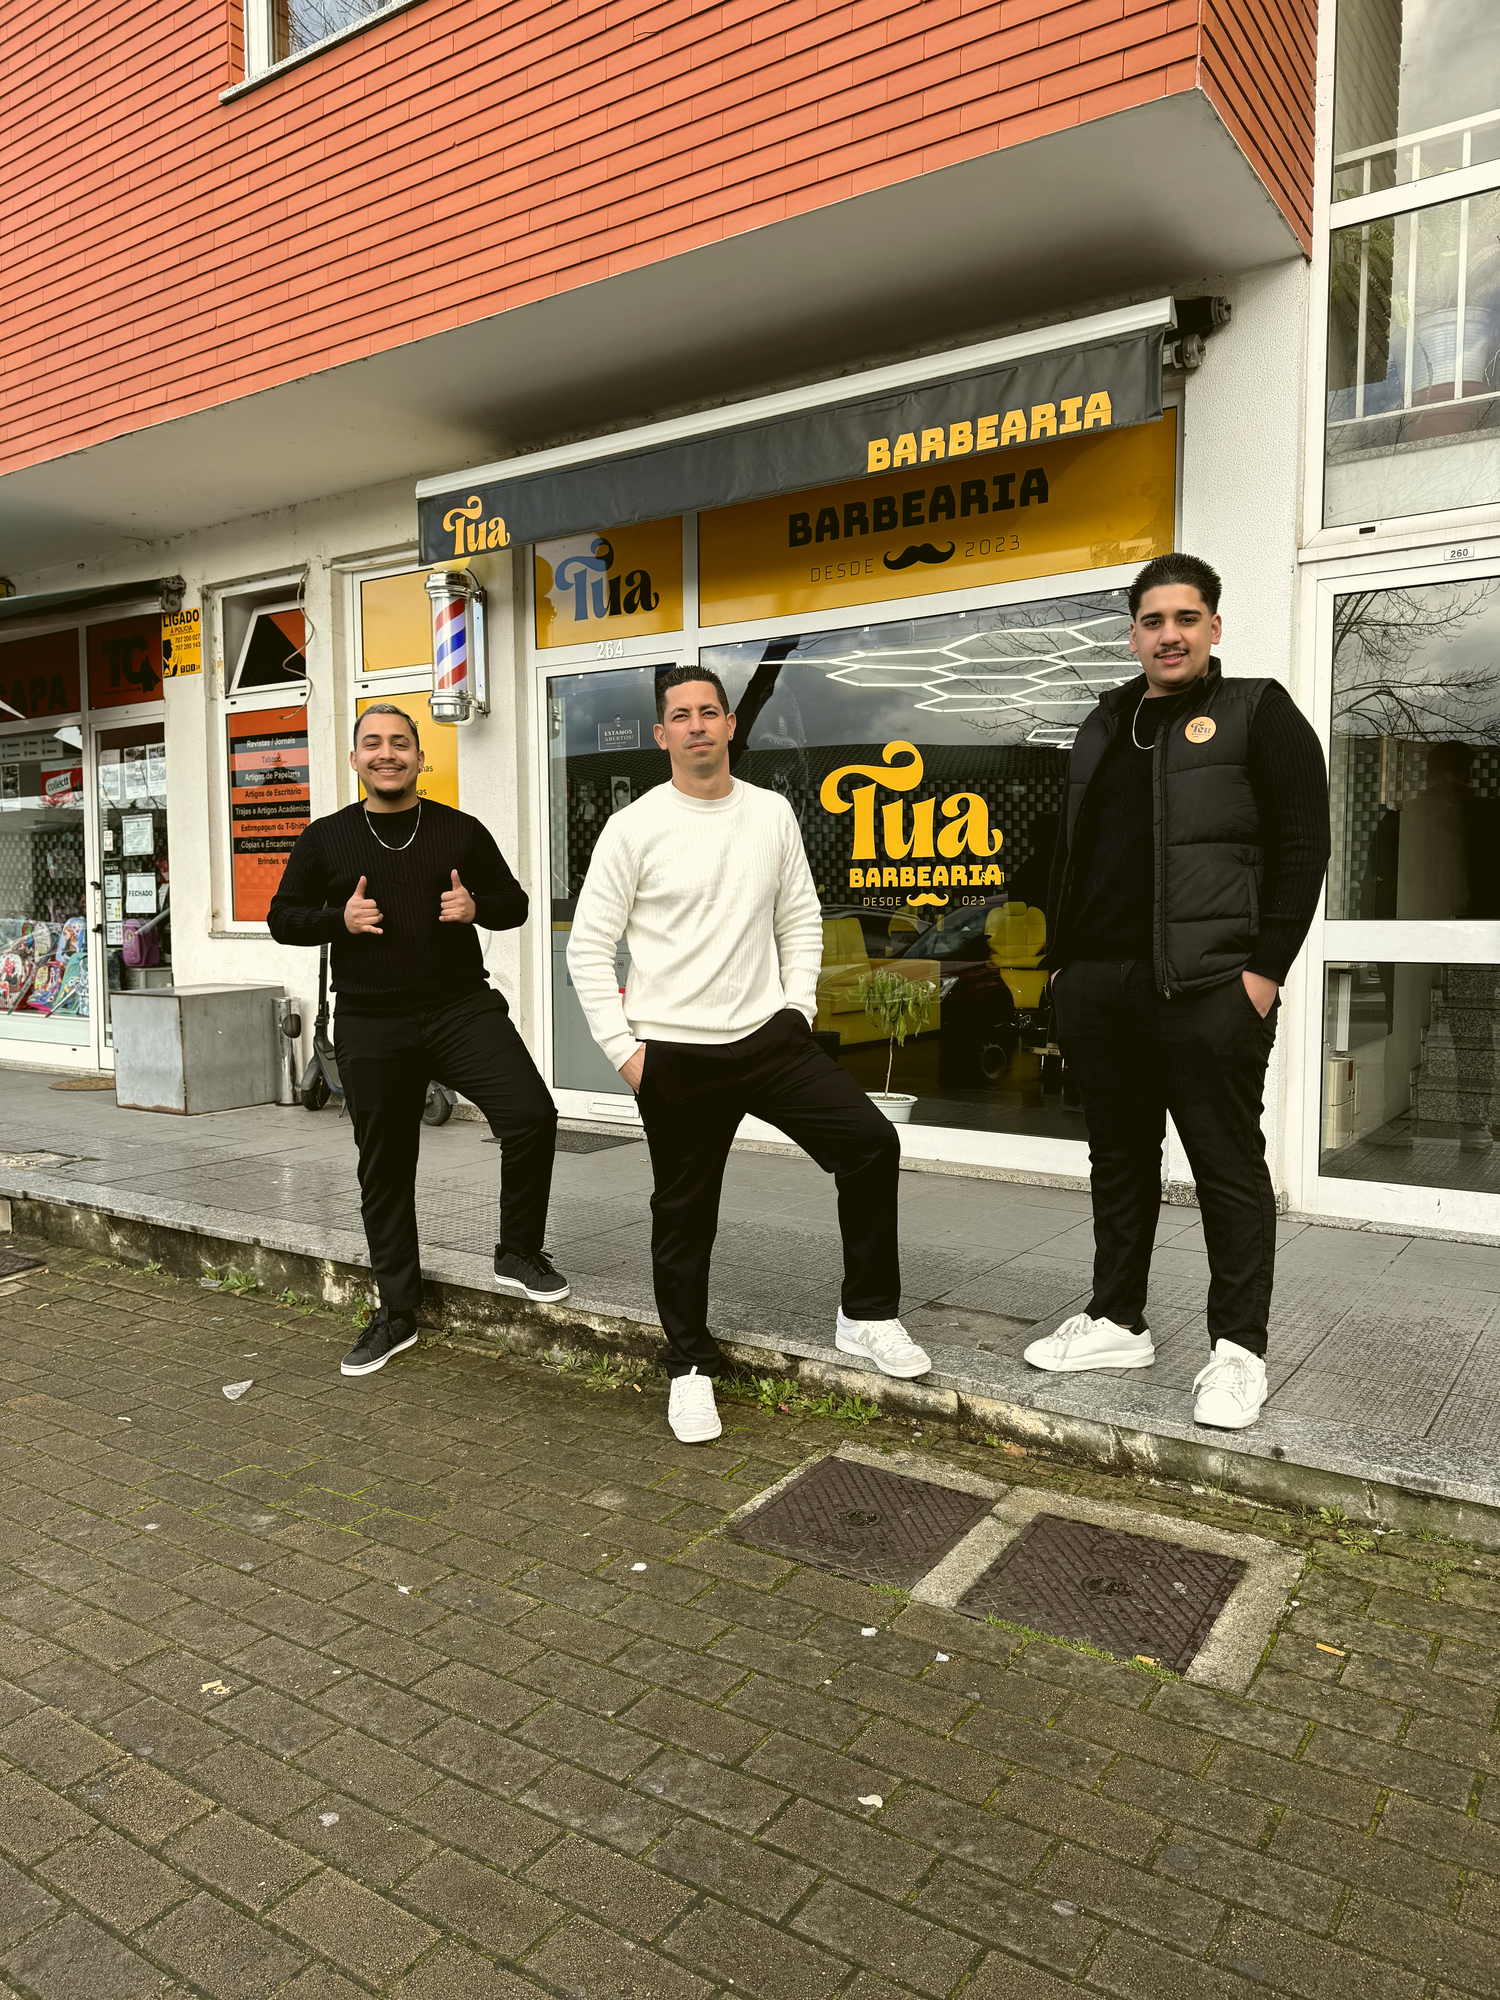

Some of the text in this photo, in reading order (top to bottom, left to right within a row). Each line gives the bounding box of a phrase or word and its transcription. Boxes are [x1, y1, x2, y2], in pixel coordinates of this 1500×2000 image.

[867, 390, 1112, 473] BARBEARIA
[788, 467, 1049, 548] BARBEARIA
[442, 495, 510, 555] Tua
[810, 534, 1020, 582] DESDE 2023
[1450, 548, 1469, 558] 260
[554, 537, 660, 622] Tua
[163, 609, 199, 628] LIGADO
[595, 641, 624, 660] 264
[246, 739, 270, 748] Revistas
[274, 736, 296, 746] Jornais
[245, 773, 265, 782] Artigos
[245, 790, 265, 799] Artigos
[274, 787, 301, 796] Escritório
[820, 740, 1003, 860] Tua
[235, 807, 251, 816] Trajes
[257, 806, 277, 815] Artigos
[241, 824, 276, 832] Estampagem
[241, 840, 260, 849] Cópias
[257, 857, 281, 865] Brindes,
[849, 864, 1002, 888] BARBEARIA
[863, 897, 902, 907] DESDE
